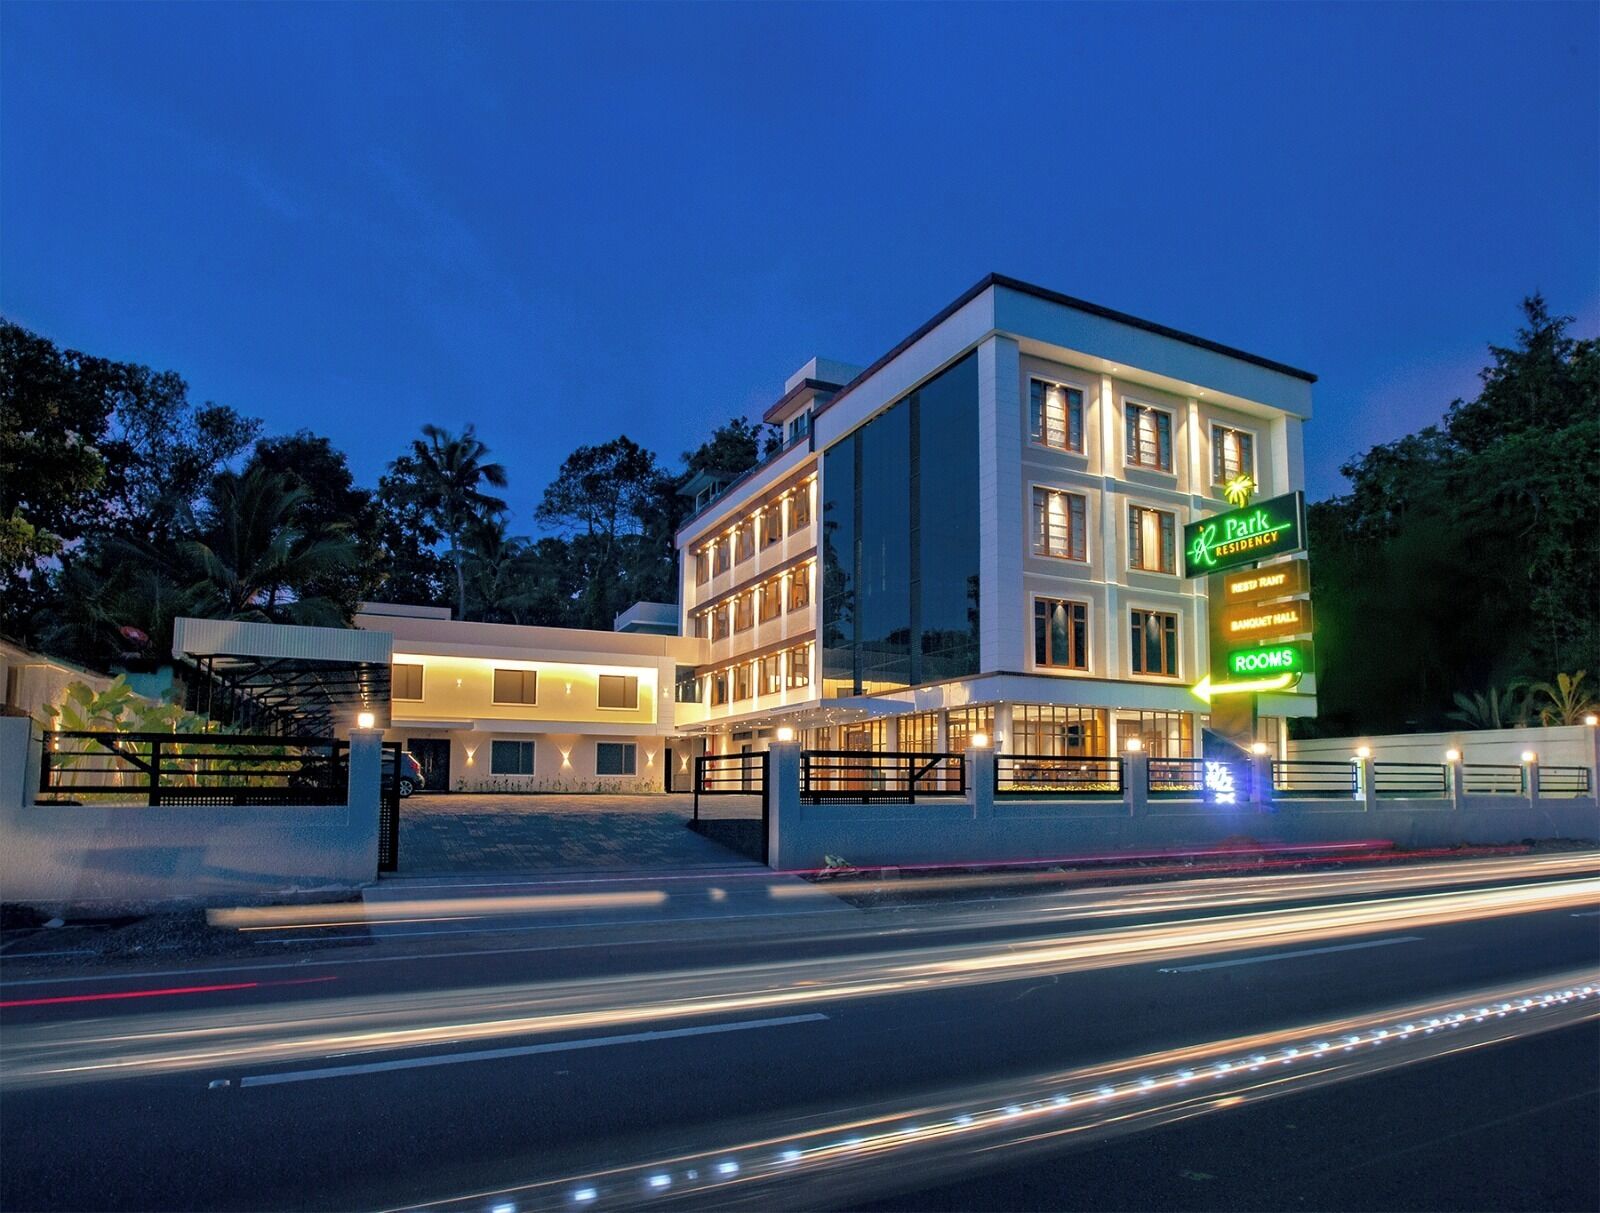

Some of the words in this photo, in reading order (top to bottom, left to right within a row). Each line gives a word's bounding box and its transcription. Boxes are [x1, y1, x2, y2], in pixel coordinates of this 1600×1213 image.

[1225, 511, 1269, 540] Park
[1216, 531, 1278, 556] RESIDENCY
[1231, 574, 1285, 594] RESTARANT
[1231, 615, 1272, 632] BANQUET
[1273, 611, 1298, 625] HALL
[1235, 649, 1292, 672] ROOMS
